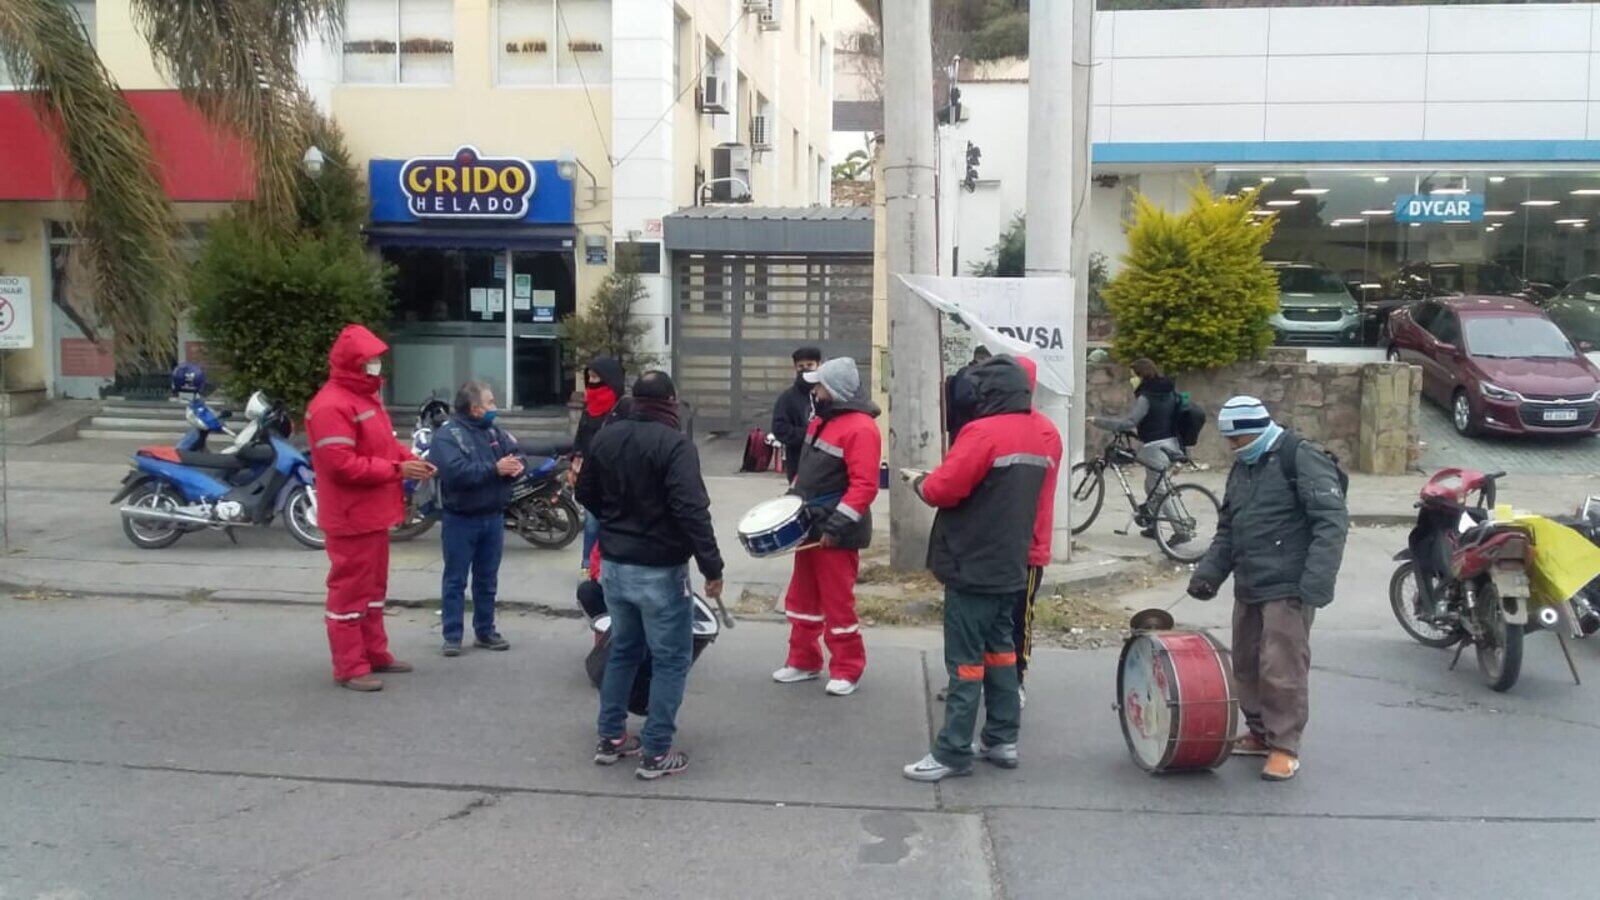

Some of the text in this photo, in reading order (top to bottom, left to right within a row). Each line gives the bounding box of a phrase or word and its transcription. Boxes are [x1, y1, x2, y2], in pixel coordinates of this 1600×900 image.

[408, 166, 525, 194] GRIDO
[416, 198, 514, 212] HELADO
[1409, 200, 1471, 217] DYCAR
